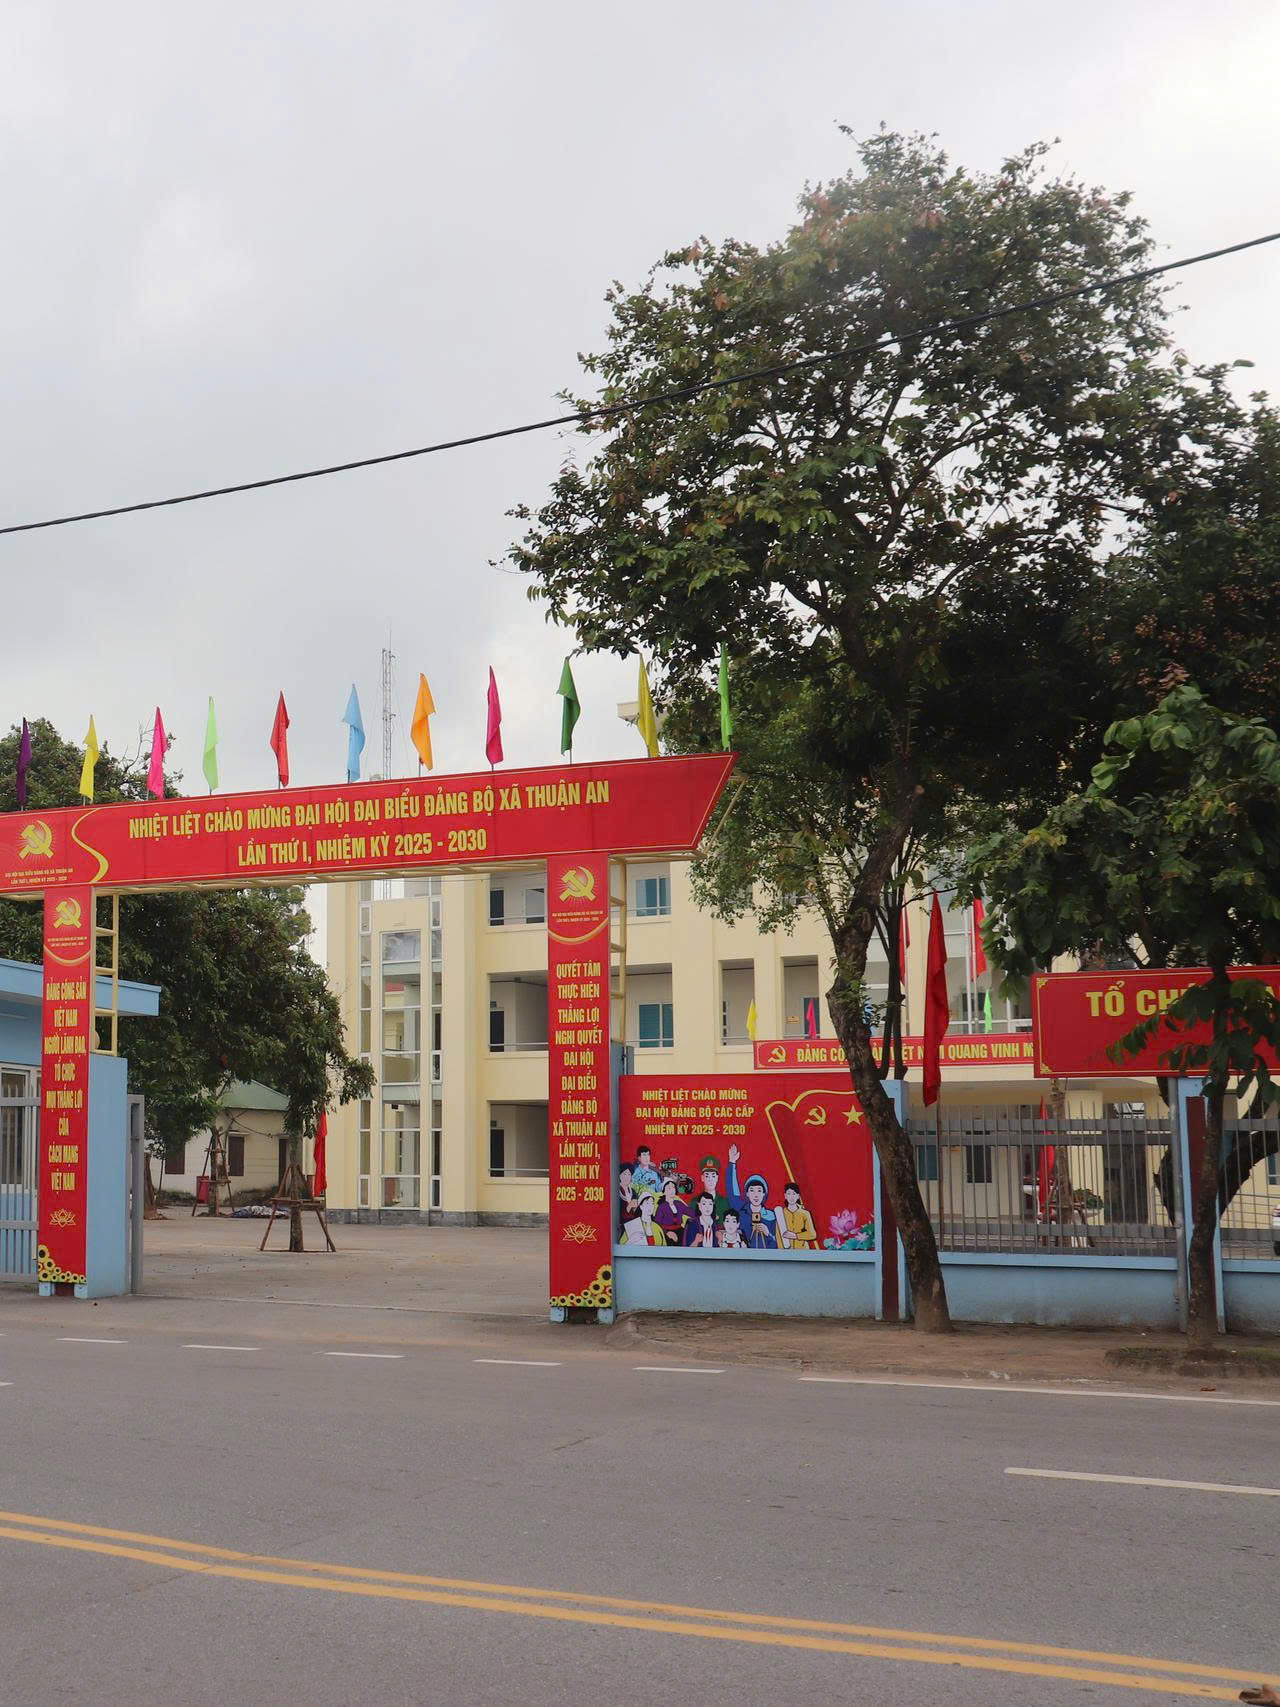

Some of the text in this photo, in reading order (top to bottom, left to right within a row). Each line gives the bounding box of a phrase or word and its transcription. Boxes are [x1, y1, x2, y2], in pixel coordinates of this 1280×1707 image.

[129, 779, 610, 841] NHIỆT LIỆT CHÀO MỪNG ĐẠI HỘI ĐẠI BIỂU ĐẢNG BỘ XÃ THUẬN AN
[238, 837, 266, 866] LẦN
[270, 837, 299, 863] THỨ
[303, 841, 312, 864] I,
[316, 833, 366, 864] NHIỆM
[370, 831, 390, 858] KỲ
[394, 832, 432, 855] 2025
[448, 828, 487, 852] 2030
[556, 958, 600, 979] QUYẾT TÂM
[558, 981, 600, 1002] THỰC HIỆN
[1086, 980, 1125, 1017] TỔ
[587, 1006, 600, 1026] LỢI
[555, 1024, 603, 1048] NGHỊ QUYẾT
[563, 1048, 594, 1069] ĐẠI HỘI
[797, 1043, 827, 1063] ĐẢNG
[830, 1045, 846, 1064] CỘ
[948, 1043, 988, 1061] QUANG
[991, 1042, 1020, 1059] VINH
[561, 1069, 597, 1094] ĐẠI BIỂU
[561, 1094, 597, 1117] ĐẢNG BỘ
[642, 1088, 748, 1103] NHIỆT LIỆT CHÀO MỪNG
[636, 1103, 755, 1120] ĐẠI HỘI ĐẢNG BỘ CÁC CẤP
[553, 1118, 607, 1139] XÃ THUẬN AN
[644, 1123, 675, 1137] NHIỆM
[677, 1122, 689, 1135] KỲ
[691, 1124, 714, 1135] 2025
[722, 1124, 746, 1135] 2030
[559, 1138, 601, 1159] LẦN THỨ I,
[560, 1162, 600, 1183] NHIỆM KỲ
[556, 1187, 576, 1201] 2025
[583, 1187, 604, 1201] 2030
